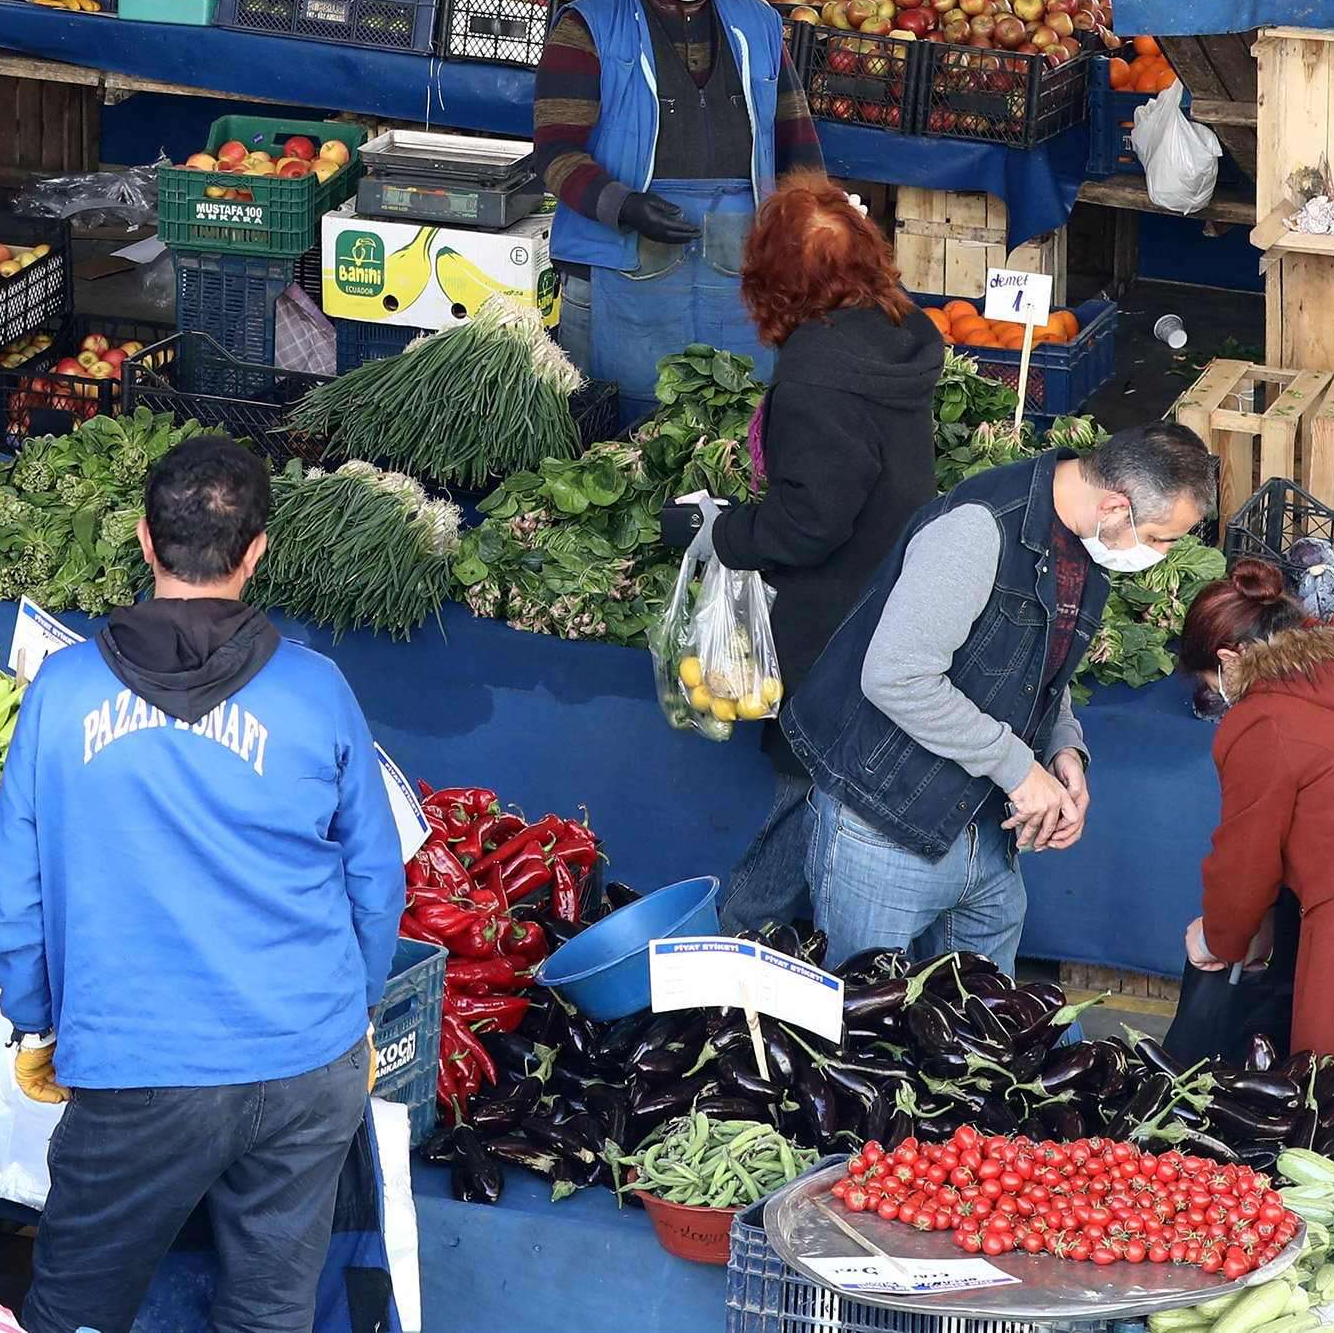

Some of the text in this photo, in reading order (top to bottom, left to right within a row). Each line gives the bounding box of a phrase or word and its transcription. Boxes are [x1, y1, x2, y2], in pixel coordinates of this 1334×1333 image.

[196, 203, 263, 218] MUSTAFA 100
[196, 214, 263, 225] ANKARA
[338, 265, 382, 286] Banini
[345, 286, 375, 296] ECUADOR
[674, 943, 739, 952] FİYAT ETİKETİ
[765, 955, 823, 983] FİYAT ETİKETİ
